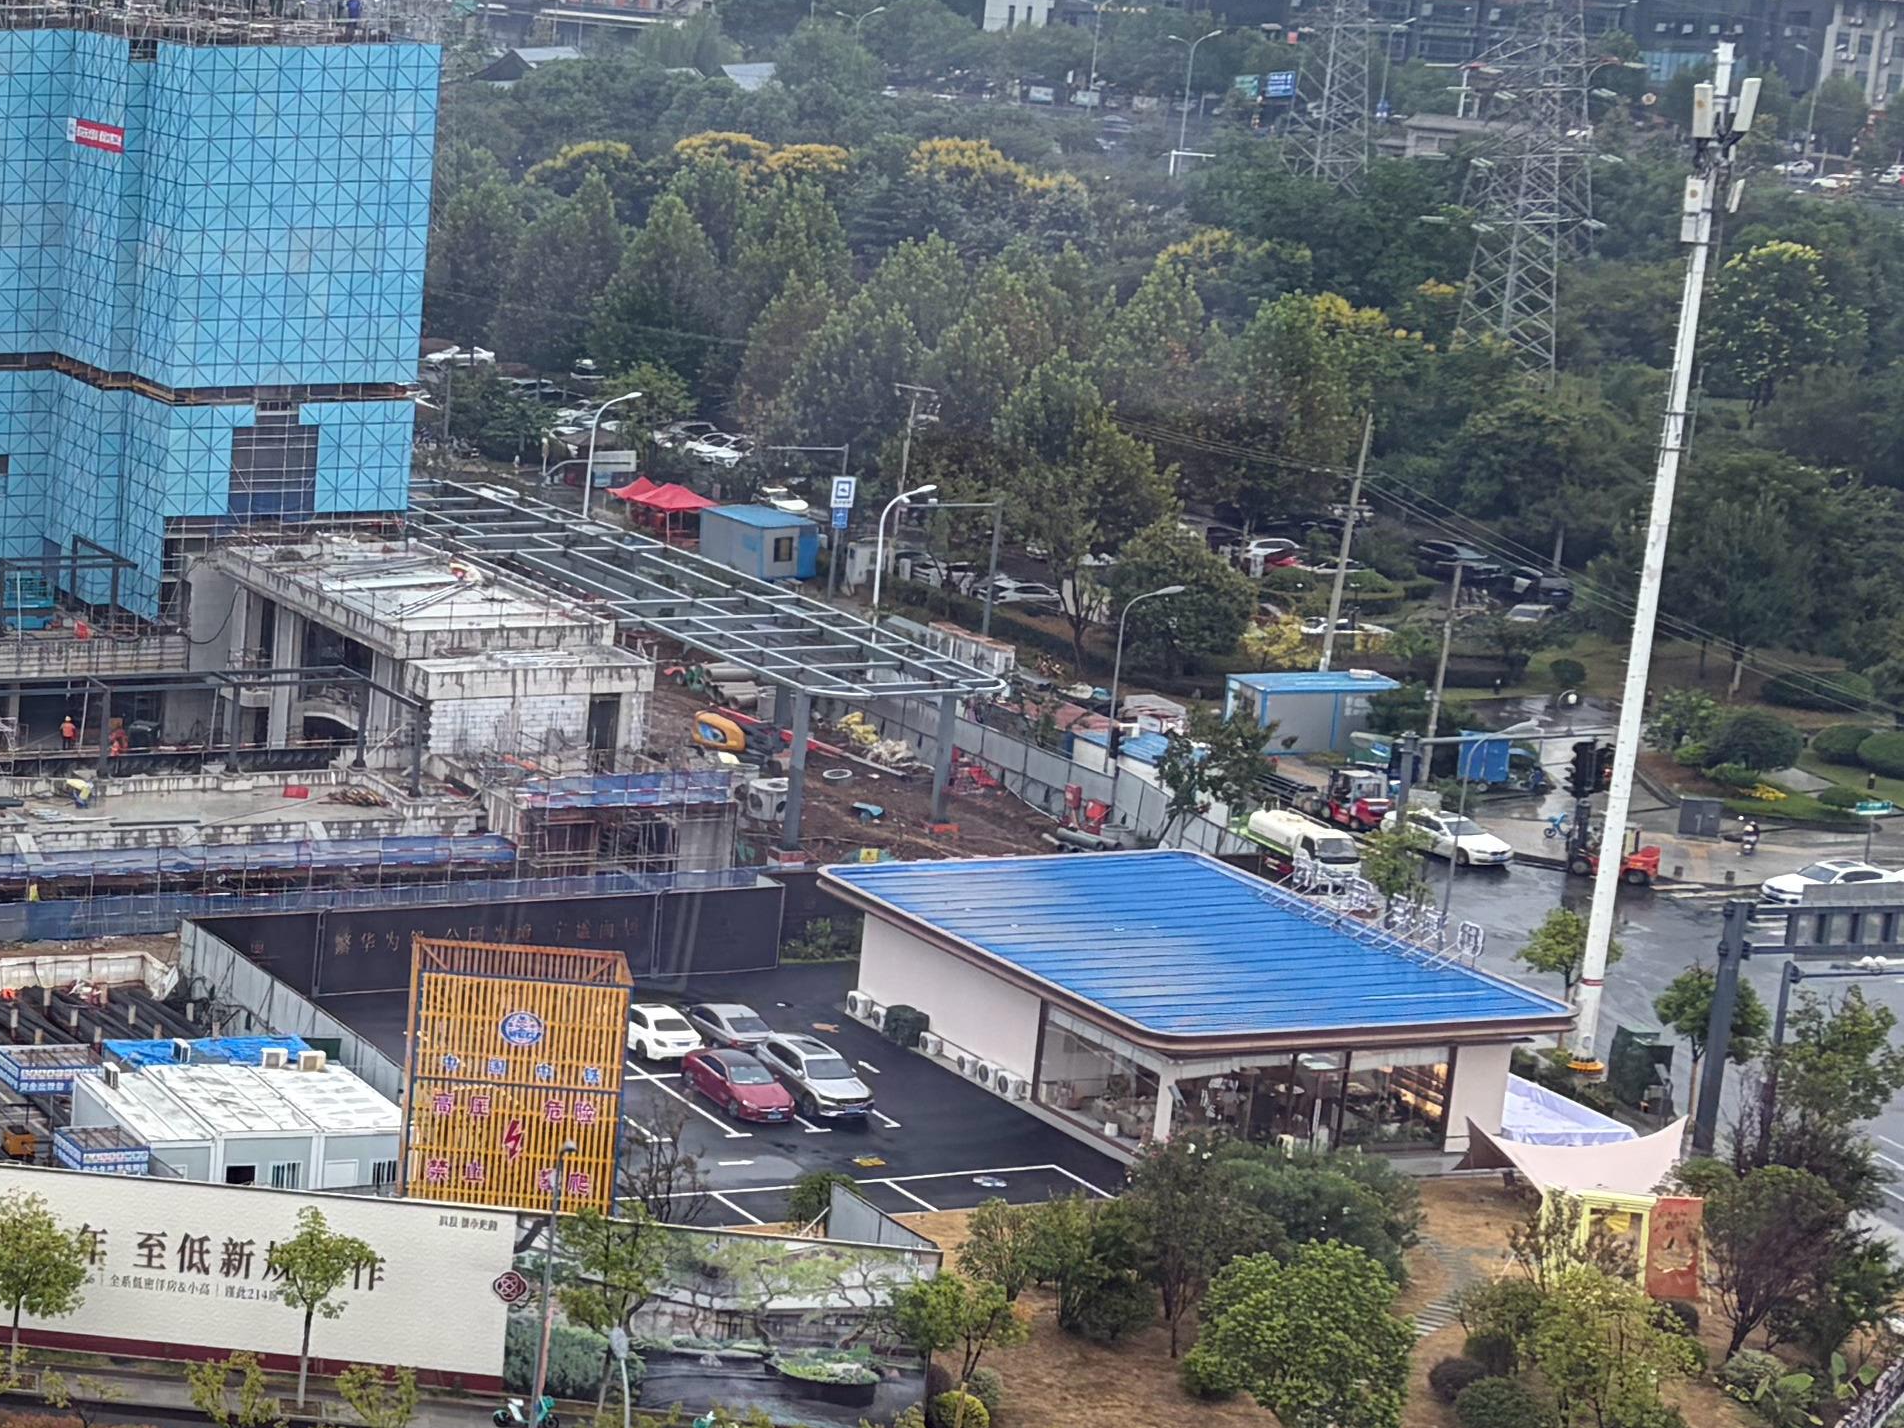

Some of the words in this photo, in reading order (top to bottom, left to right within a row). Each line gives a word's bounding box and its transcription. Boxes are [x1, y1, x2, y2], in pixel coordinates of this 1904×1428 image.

[443, 1053, 601, 1086] 中国中铁
[433, 1093, 491, 1116] 高压
[545, 1099, 598, 1123] 危险
[427, 1159, 485, 1184] 禁止
[133, 1230, 387, 1292] 至低新规作
